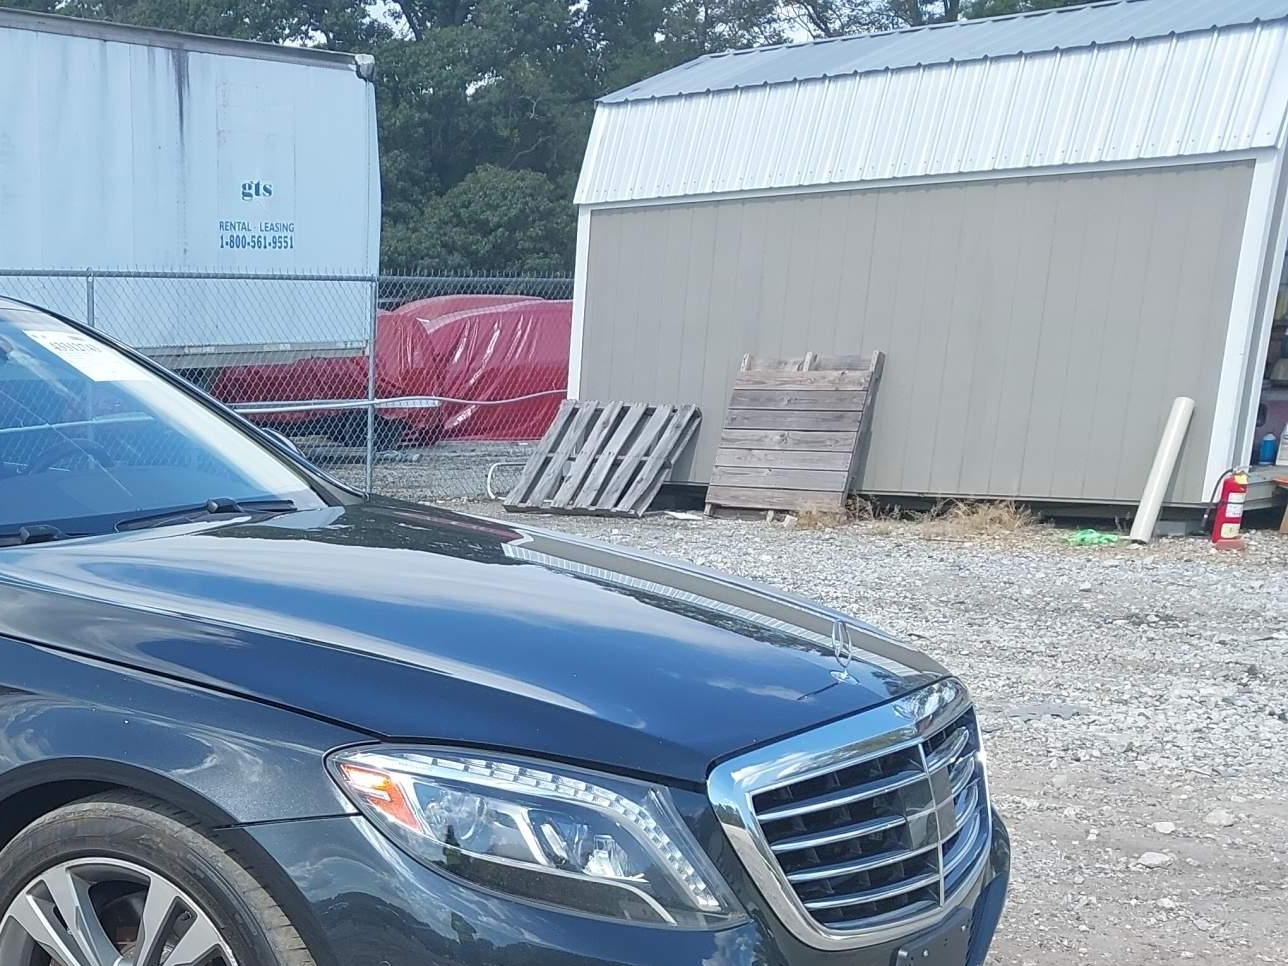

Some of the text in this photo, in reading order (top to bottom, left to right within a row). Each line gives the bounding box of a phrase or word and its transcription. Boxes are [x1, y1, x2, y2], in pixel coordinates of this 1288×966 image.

[241, 180, 273, 201] gts
[219, 221, 295, 233] RENTAL LEASING
